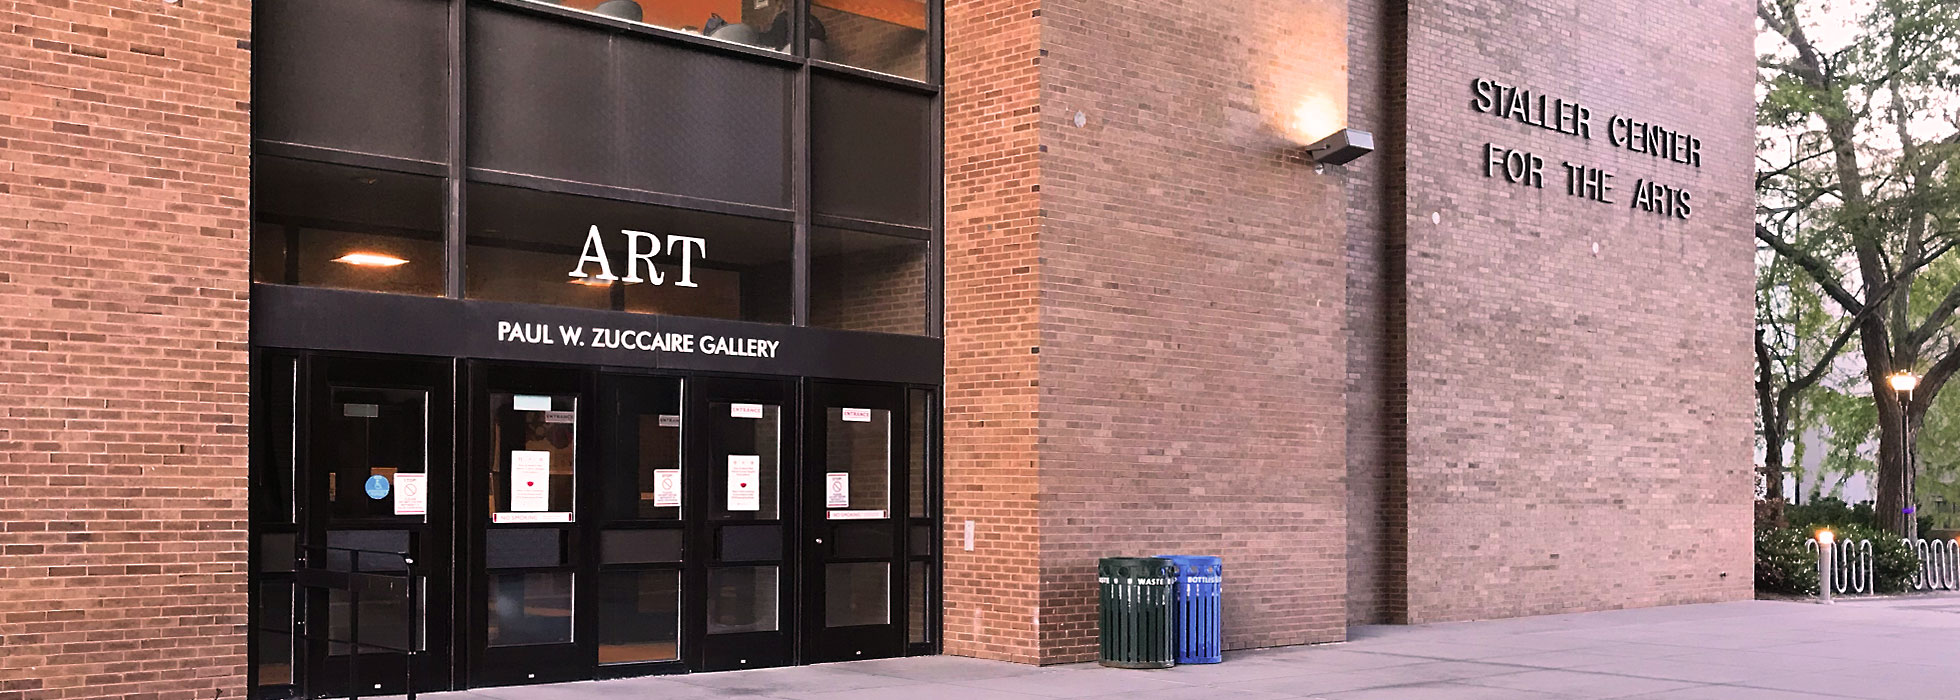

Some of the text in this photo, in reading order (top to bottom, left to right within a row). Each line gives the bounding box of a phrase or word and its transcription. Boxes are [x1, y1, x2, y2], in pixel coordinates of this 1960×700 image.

[1471, 77, 1701, 168] STALLER CENTER
[1485, 142, 1692, 219] FOR THE ARTS
[568, 224, 706, 288] ART
[498, 321, 780, 359] PAUL W. ZUCCAIRE GALLERY
